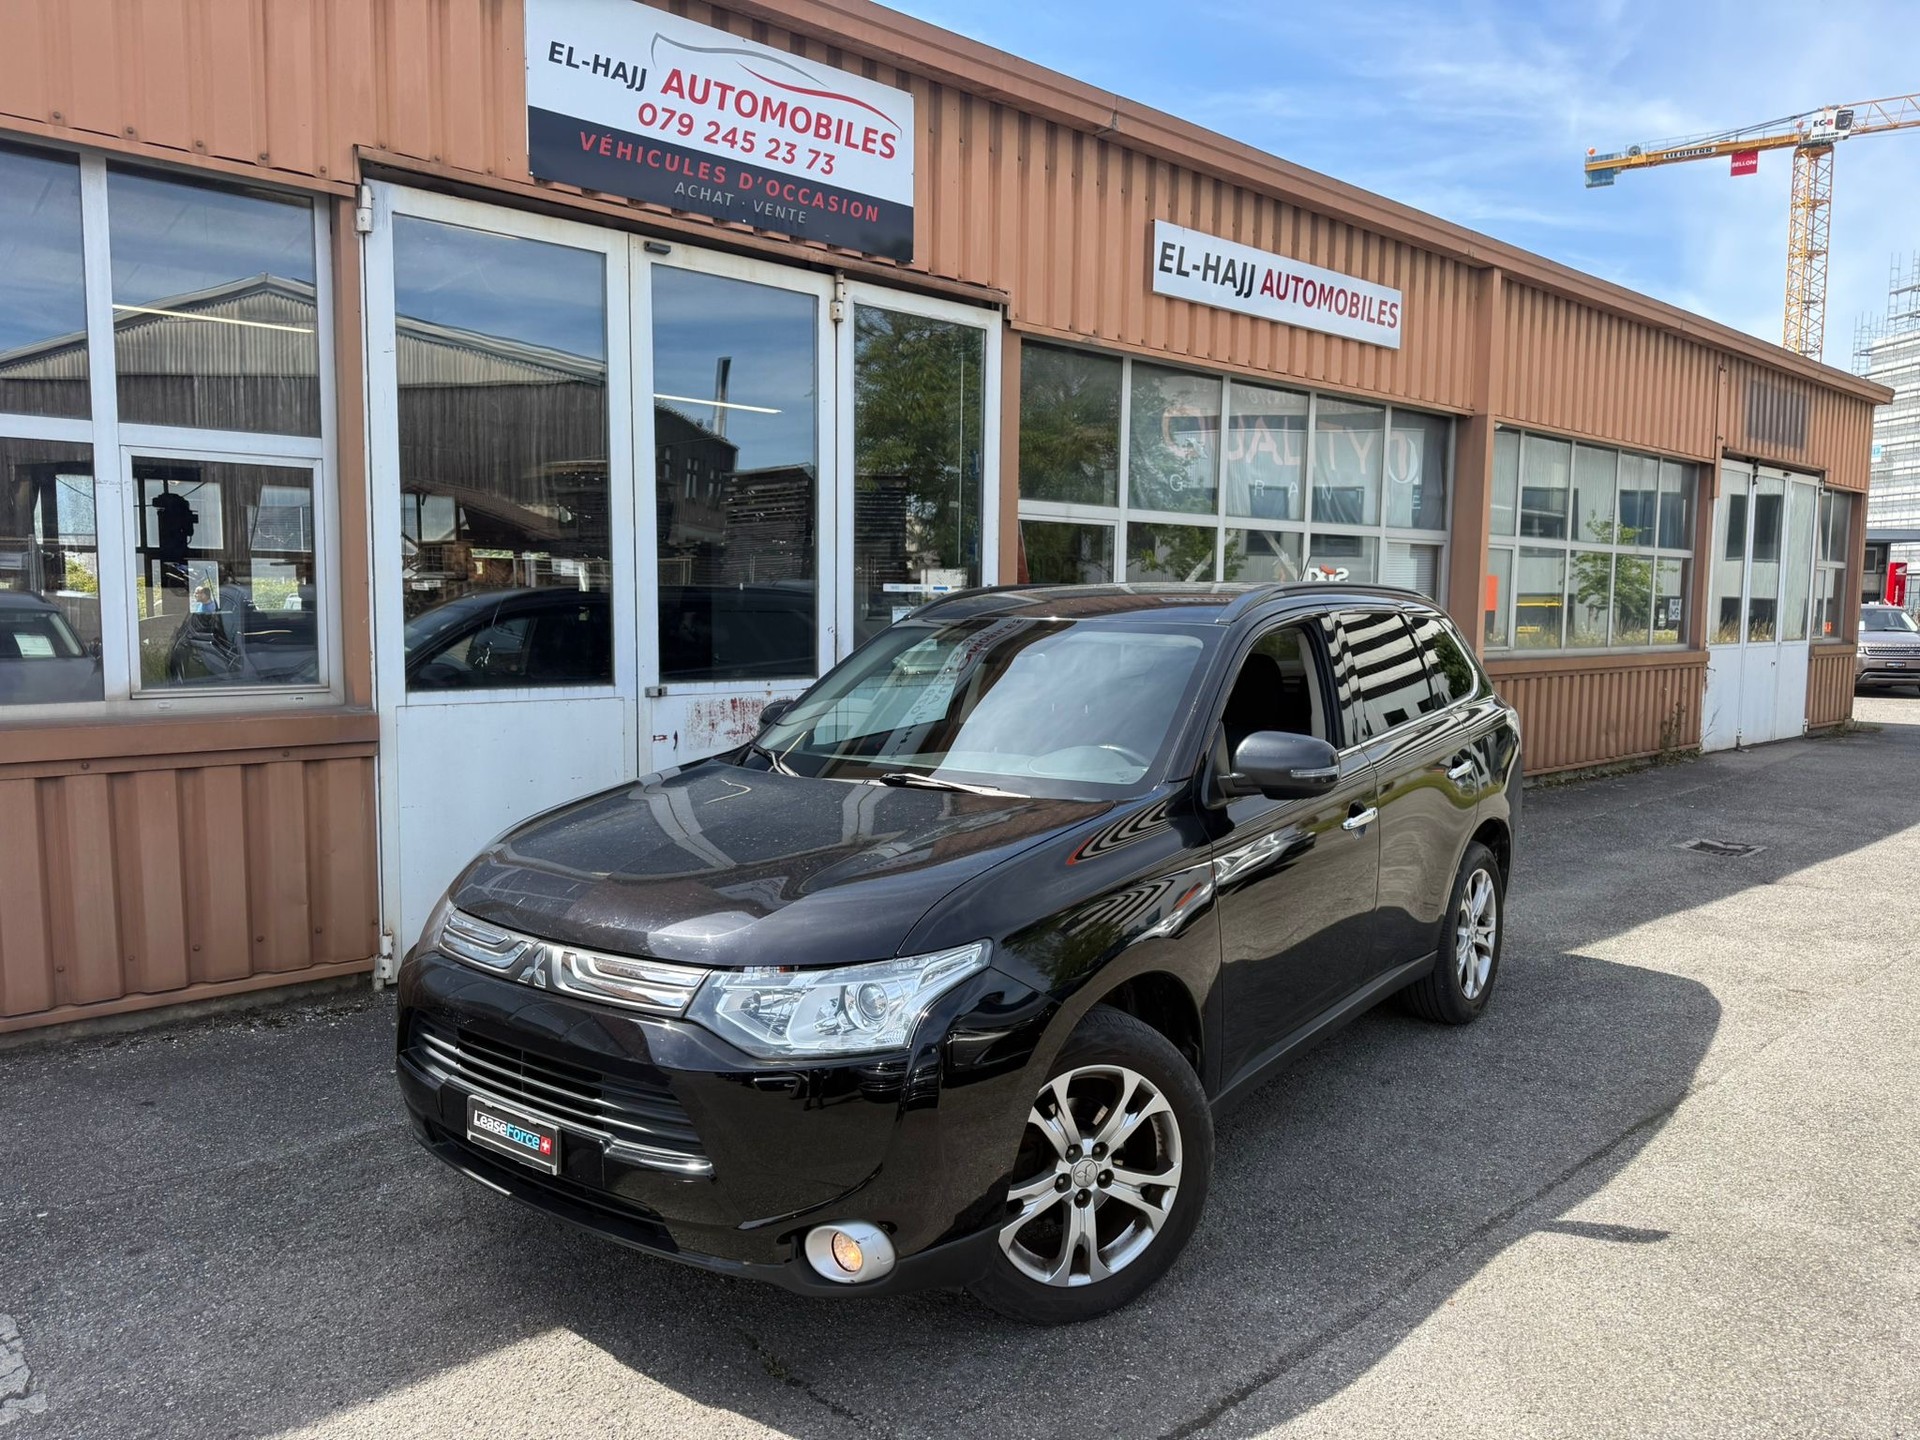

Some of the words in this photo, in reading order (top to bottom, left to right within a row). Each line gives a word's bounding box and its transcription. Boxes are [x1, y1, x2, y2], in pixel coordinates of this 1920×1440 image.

[548, 41, 647, 92] EL-HAJJ
[660, 68, 897, 159] AUTOMOBILES
[638, 103, 694, 136] 079
[704, 121, 755, 153] 245
[765, 138, 796, 165] 23
[805, 149, 834, 175] 73
[580, 131, 727, 185] VÉHICULES
[738, 171, 879, 222] D'OCCASION
[674, 181, 735, 207] ACHAT
[753, 200, 807, 224] VENTE
[1158, 241, 1256, 299] EL-HAJJ
[1260, 268, 1399, 329] AUTOMOBILES
[473, 1109, 541, 1151] LeaseForce
